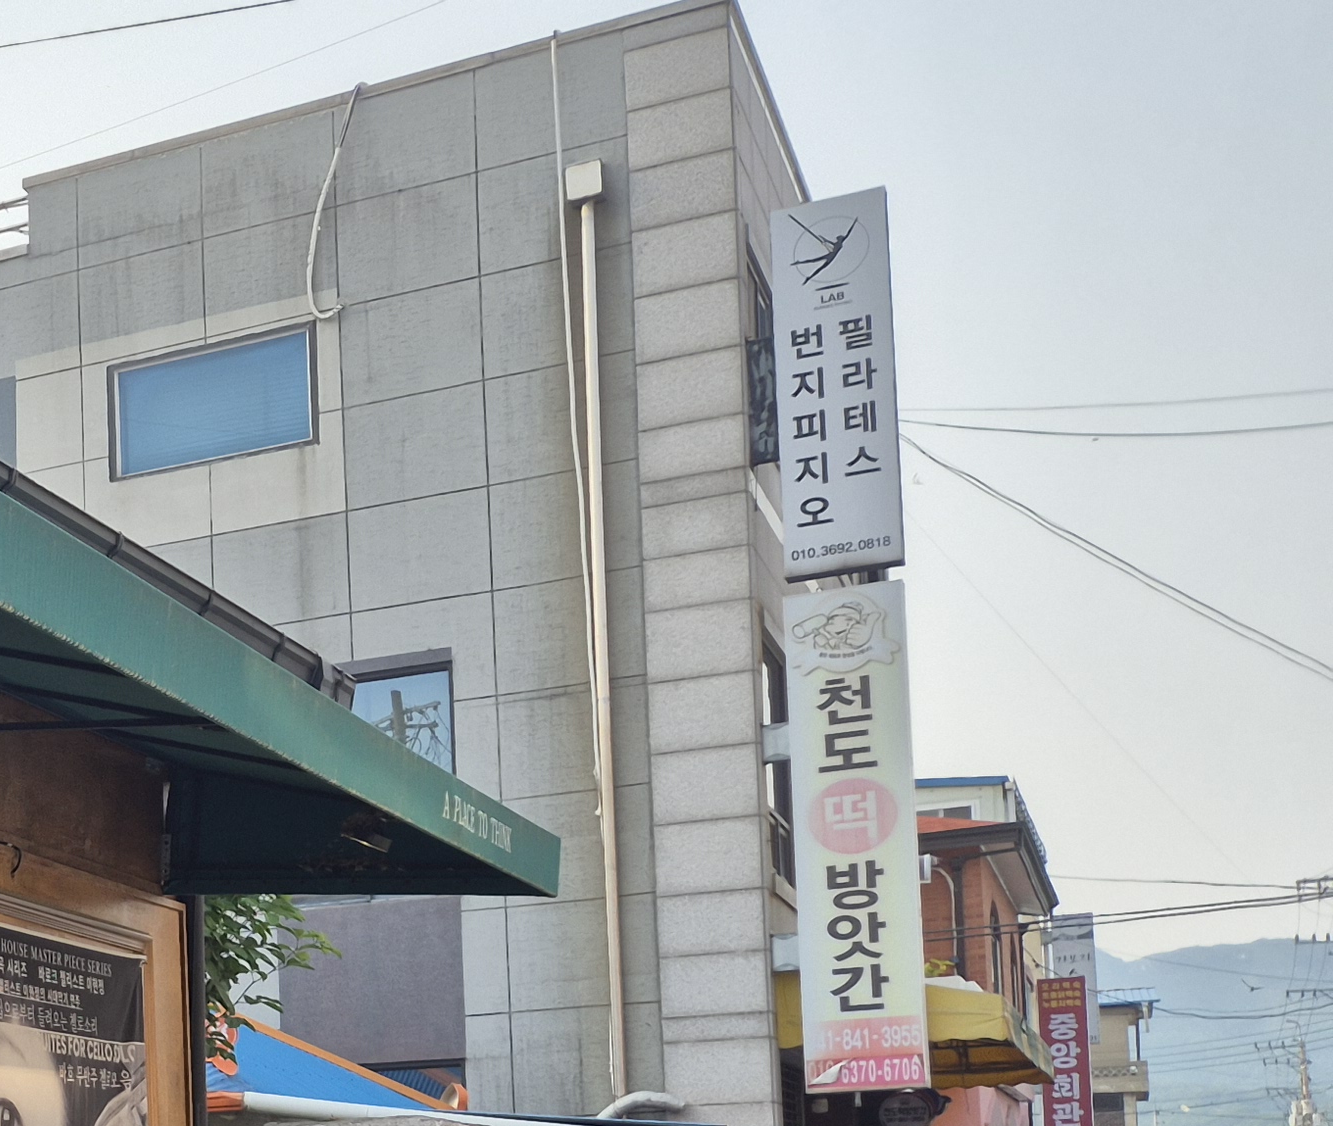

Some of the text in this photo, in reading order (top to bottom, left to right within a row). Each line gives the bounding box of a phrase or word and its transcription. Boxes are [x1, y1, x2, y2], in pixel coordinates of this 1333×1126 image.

[821, 291, 846, 305] LAB
[838, 314, 882, 477] 필라테스
[790, 324, 834, 528] 번지피지오
[791, 535, 892, 562] 010.3692.0818
[442, 790, 450, 820] A
[453, 795, 476, 834] PLACE
[477, 810, 488, 840] TO
[0, 938, 29, 959] HOUSE
[30, 945, 63, 967] MASTER
[63, 954, 86, 972] PIECE
[86, 960, 113, 978] SERIES
[68, 1036, 86, 1059] FOR
[86, 1039, 113, 1063] CELLO
